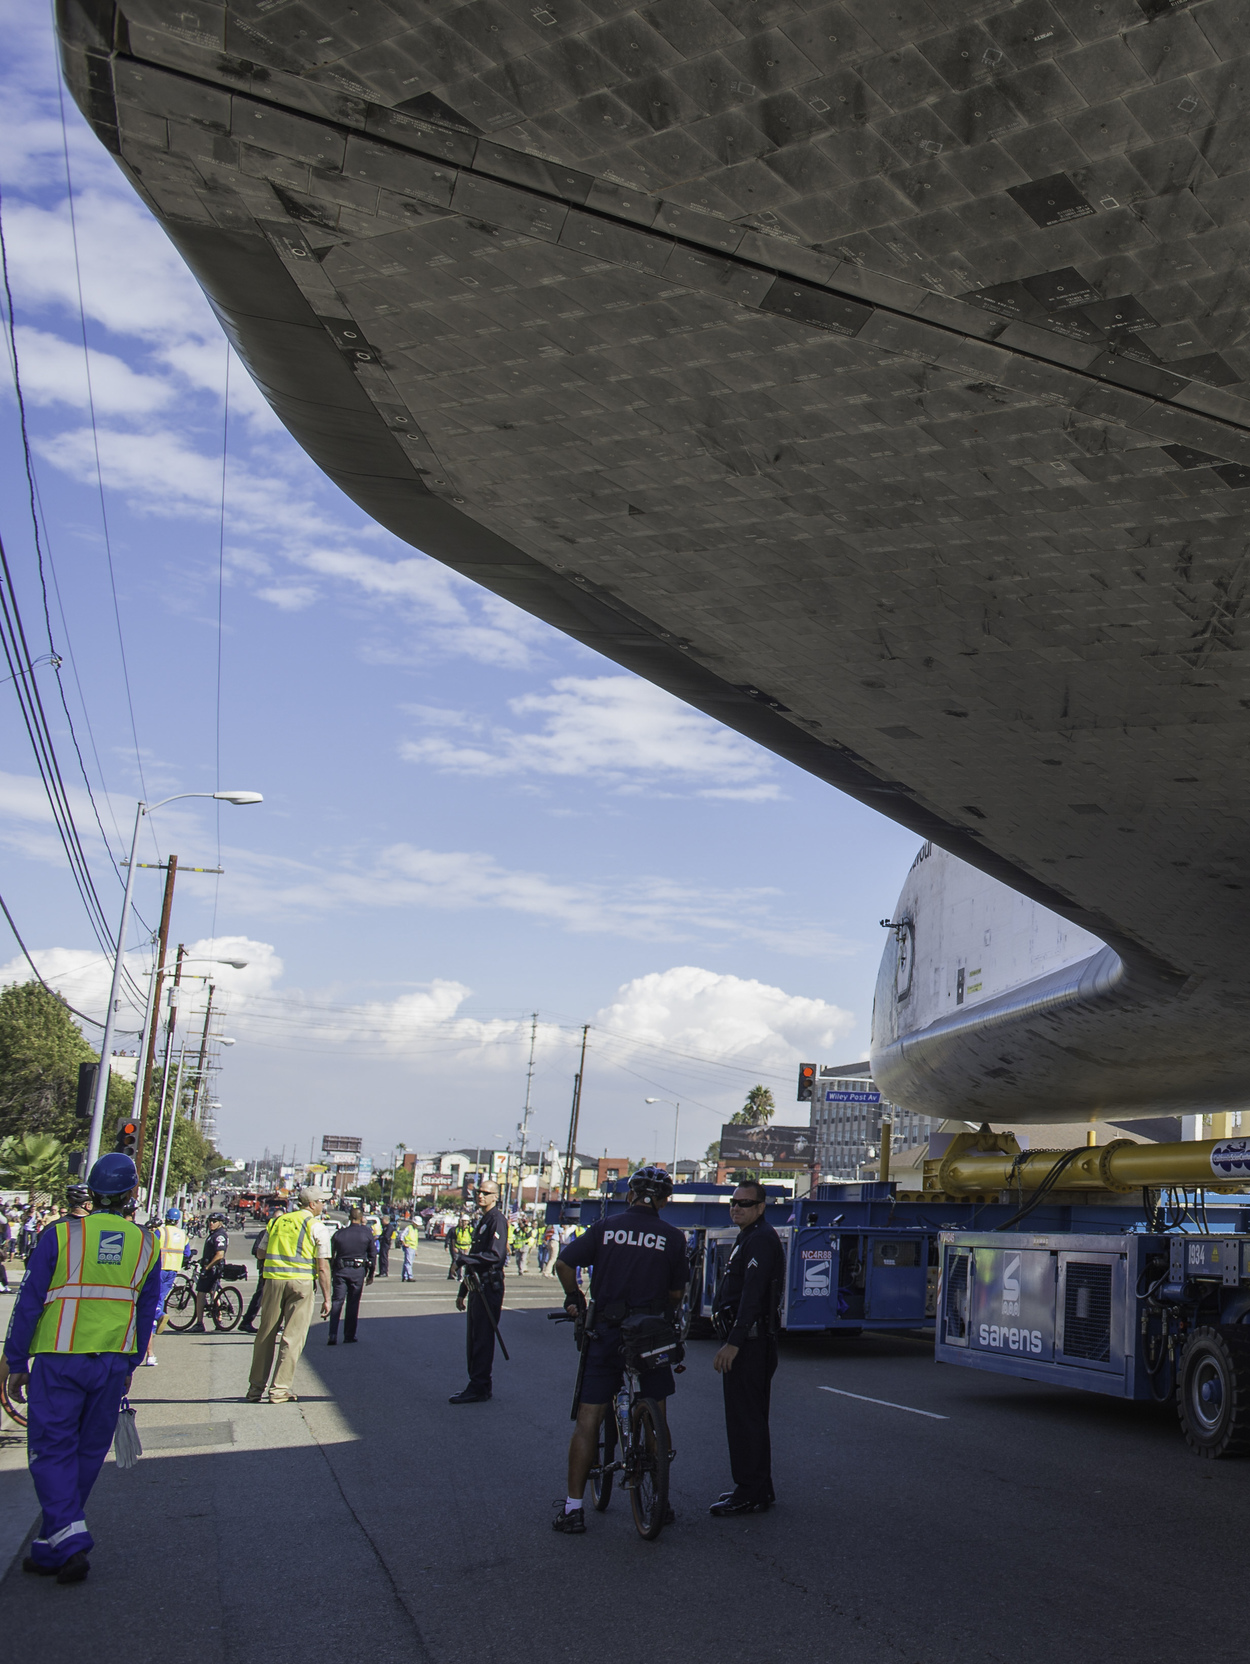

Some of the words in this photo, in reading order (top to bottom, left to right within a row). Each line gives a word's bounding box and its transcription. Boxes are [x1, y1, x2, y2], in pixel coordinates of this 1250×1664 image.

[829, 1093, 848, 1101] Wiley
[603, 1229, 667, 1251] POLICE
[802, 1251, 832, 1259] NC4R88
[1188, 1244, 1205, 1265] 1934
[979, 1324, 1043, 1354] sarens
